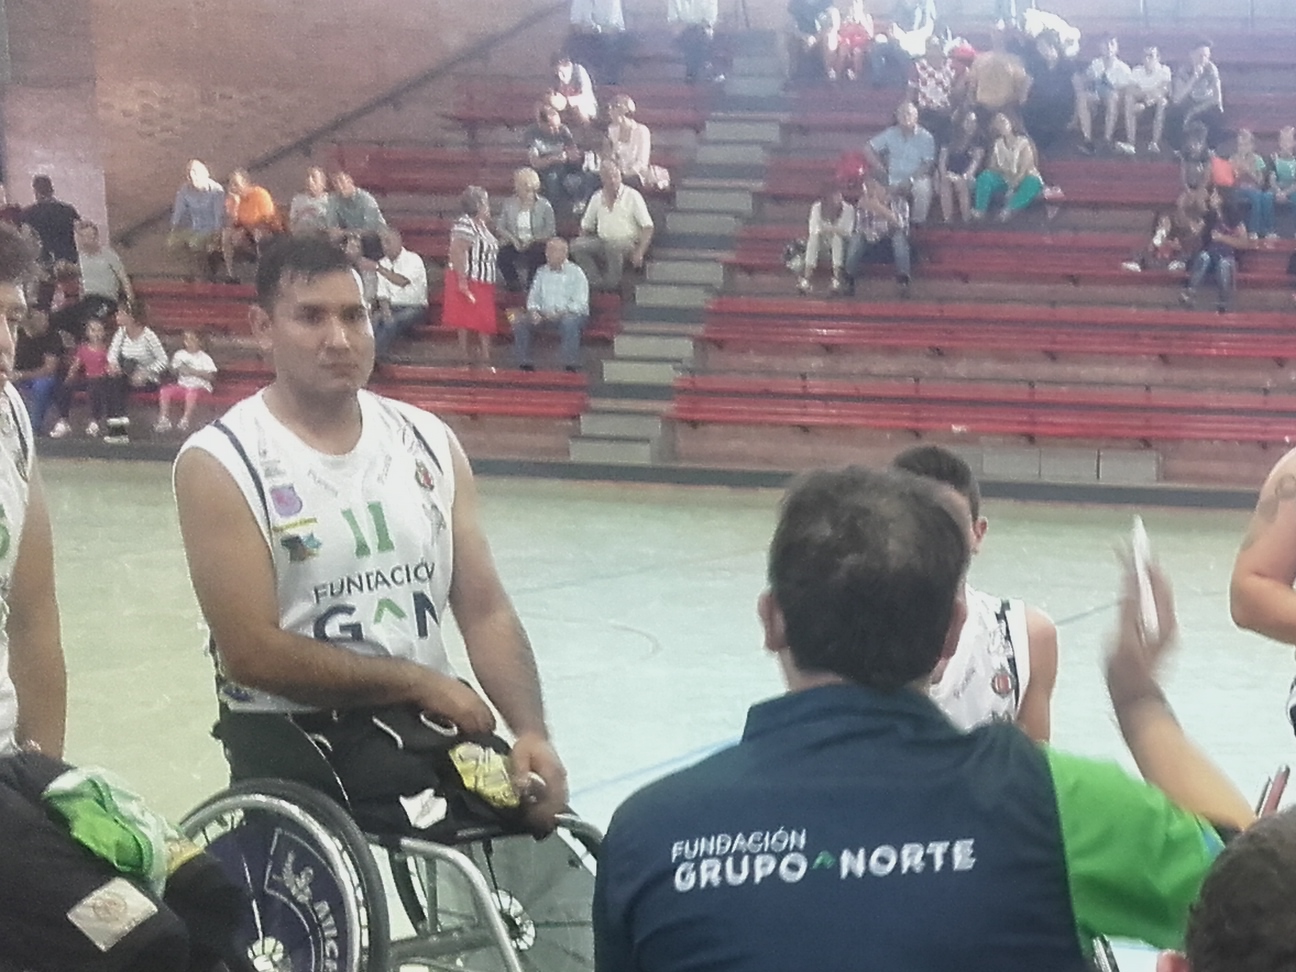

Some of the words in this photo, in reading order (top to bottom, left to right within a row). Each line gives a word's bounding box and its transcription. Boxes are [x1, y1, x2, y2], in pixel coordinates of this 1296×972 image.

[341, 502, 395, 559] 11
[671, 826, 806, 863] FUNDACIÓN
[674, 851, 808, 893] GRUPO
[840, 838, 976, 880] NORTE
